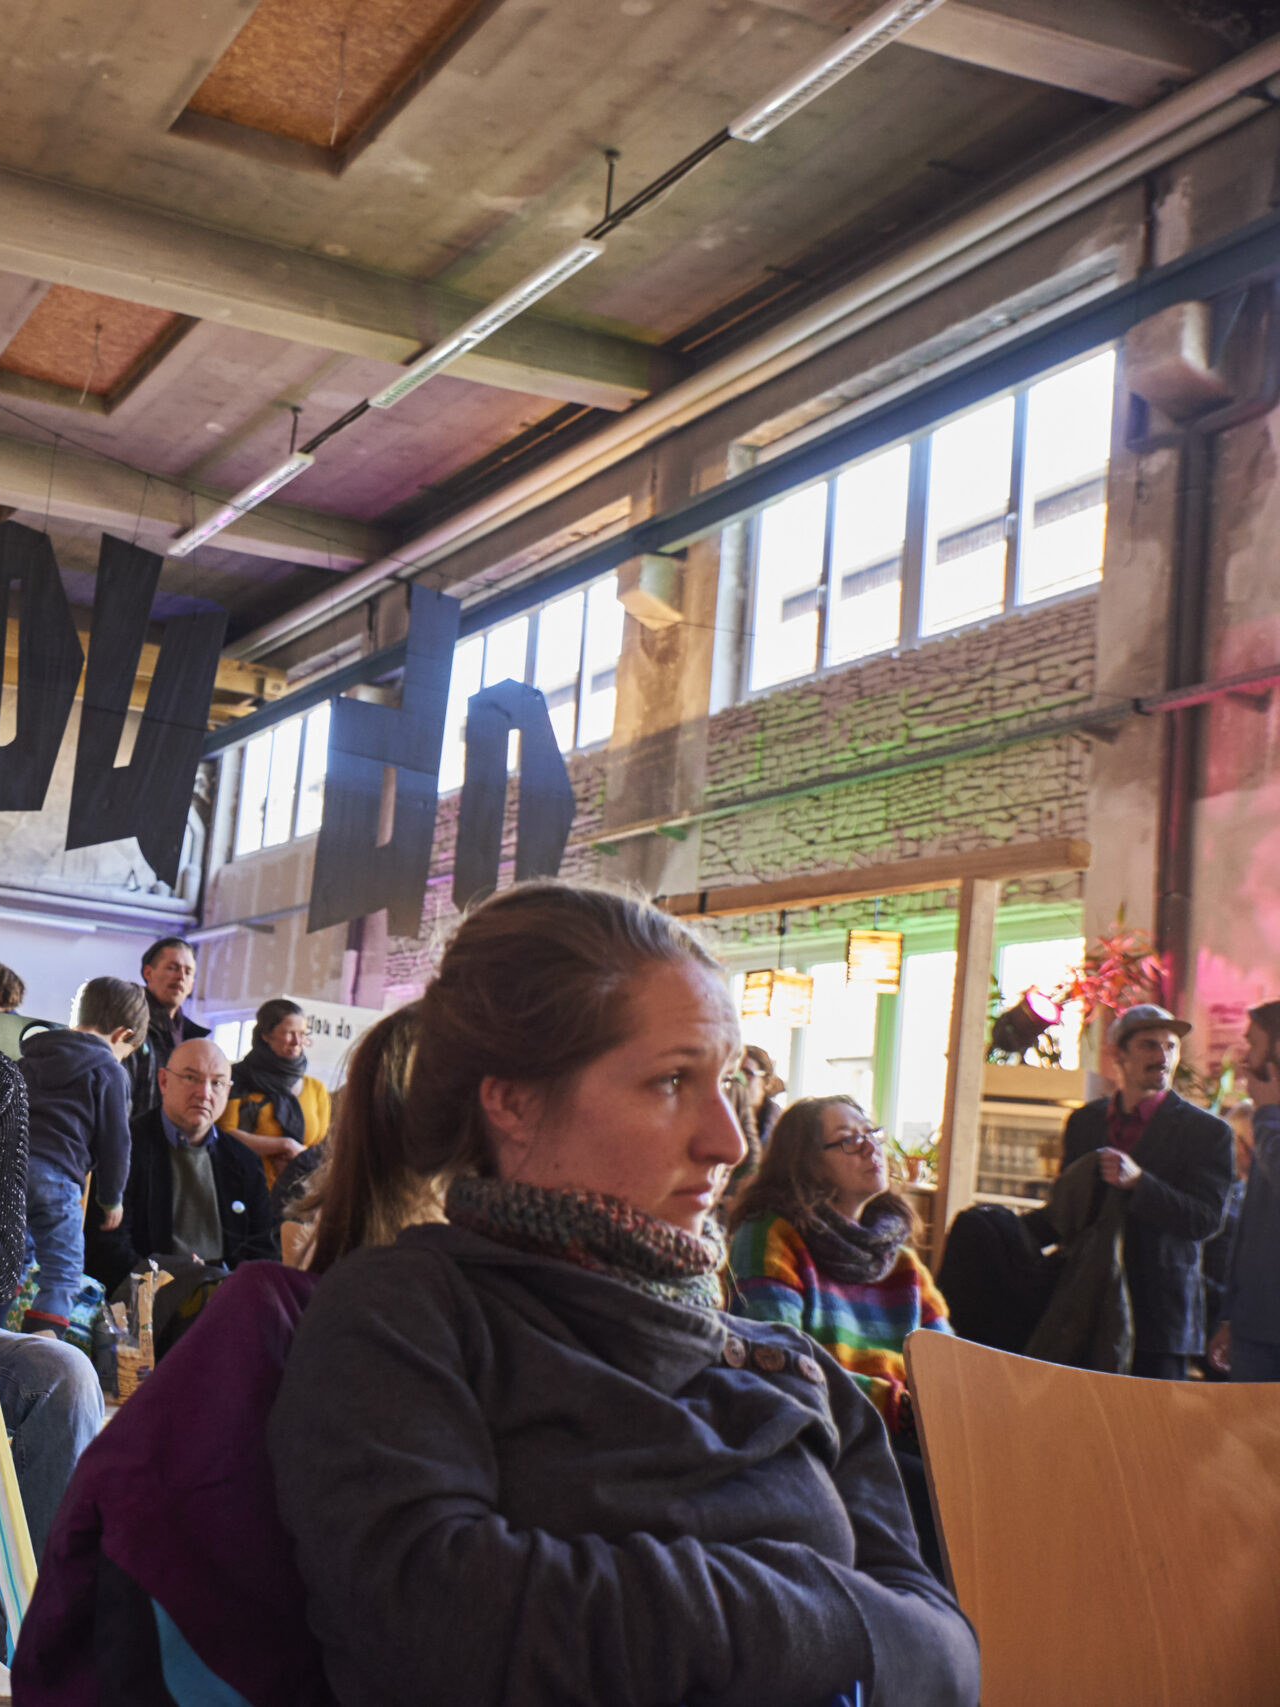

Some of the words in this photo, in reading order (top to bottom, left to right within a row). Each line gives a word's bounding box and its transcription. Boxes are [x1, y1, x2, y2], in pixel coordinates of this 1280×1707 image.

[306, 583, 576, 937] do
[303, 1015, 330, 1036] you
[336, 1017, 352, 1040] do
